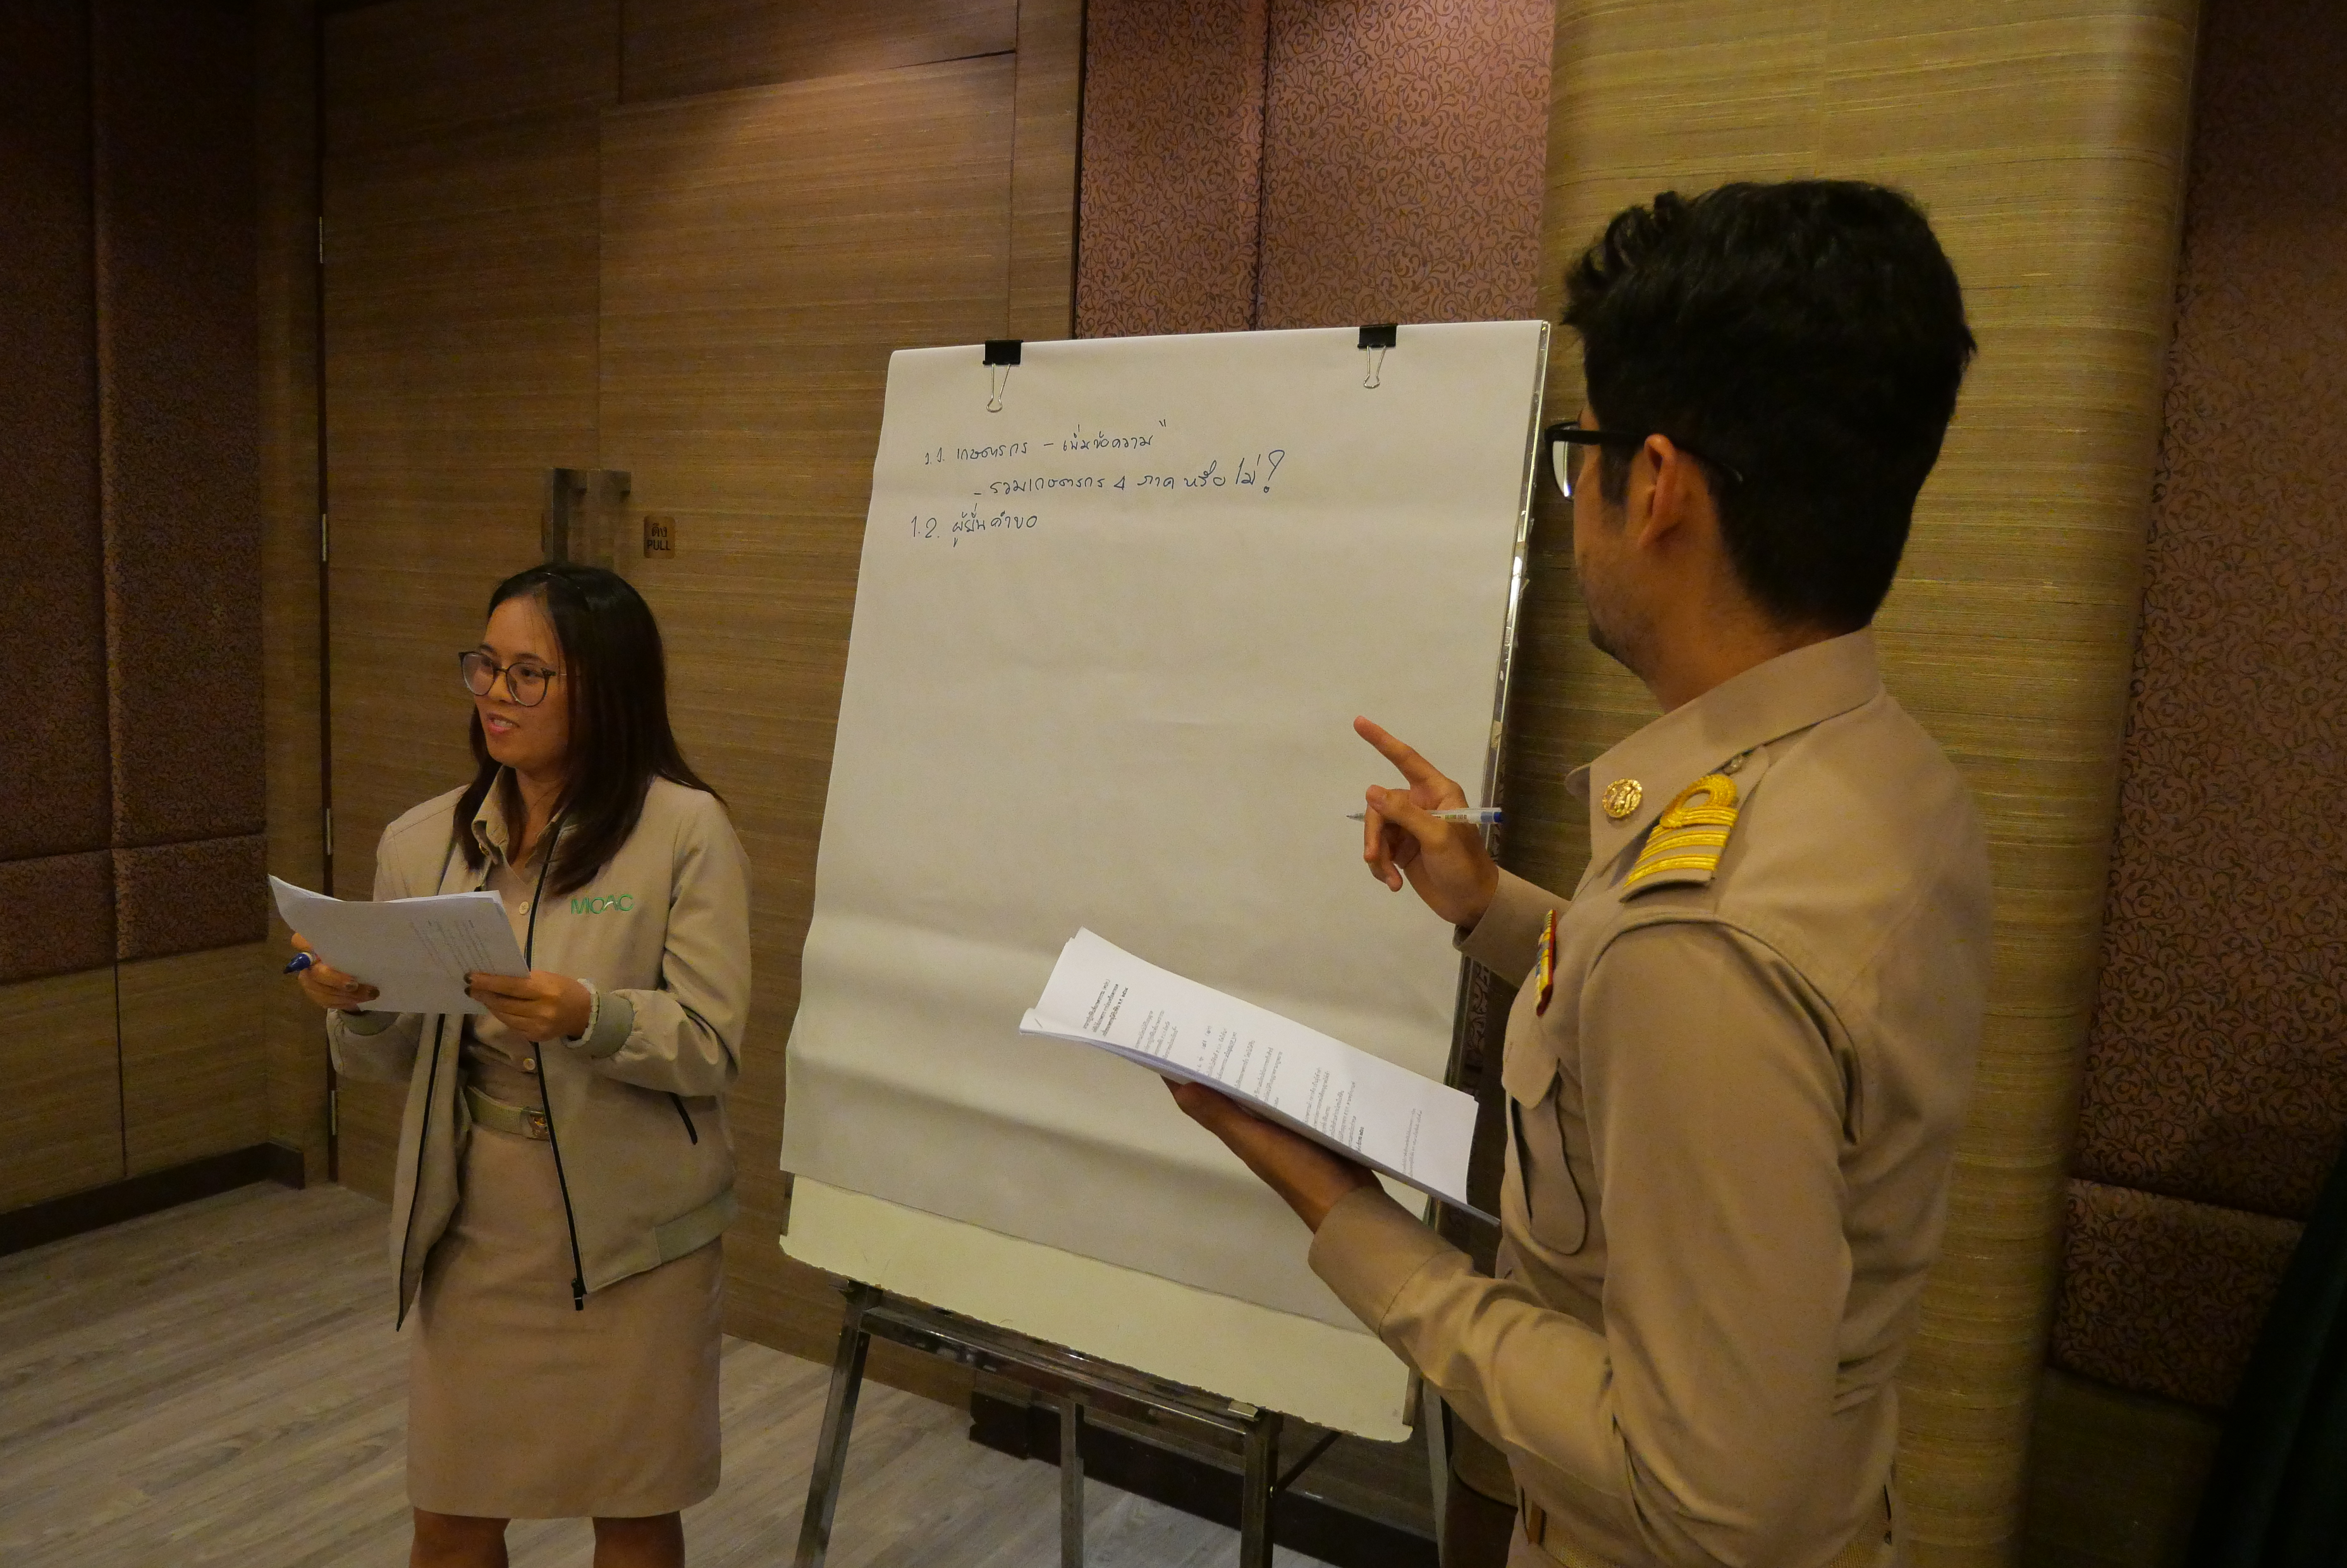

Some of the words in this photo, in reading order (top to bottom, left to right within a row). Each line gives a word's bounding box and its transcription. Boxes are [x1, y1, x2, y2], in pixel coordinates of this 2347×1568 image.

[651, 522, 668, 537] ดึง
[646, 539, 671, 551] PULL
[571, 893, 635, 915] MOAC
